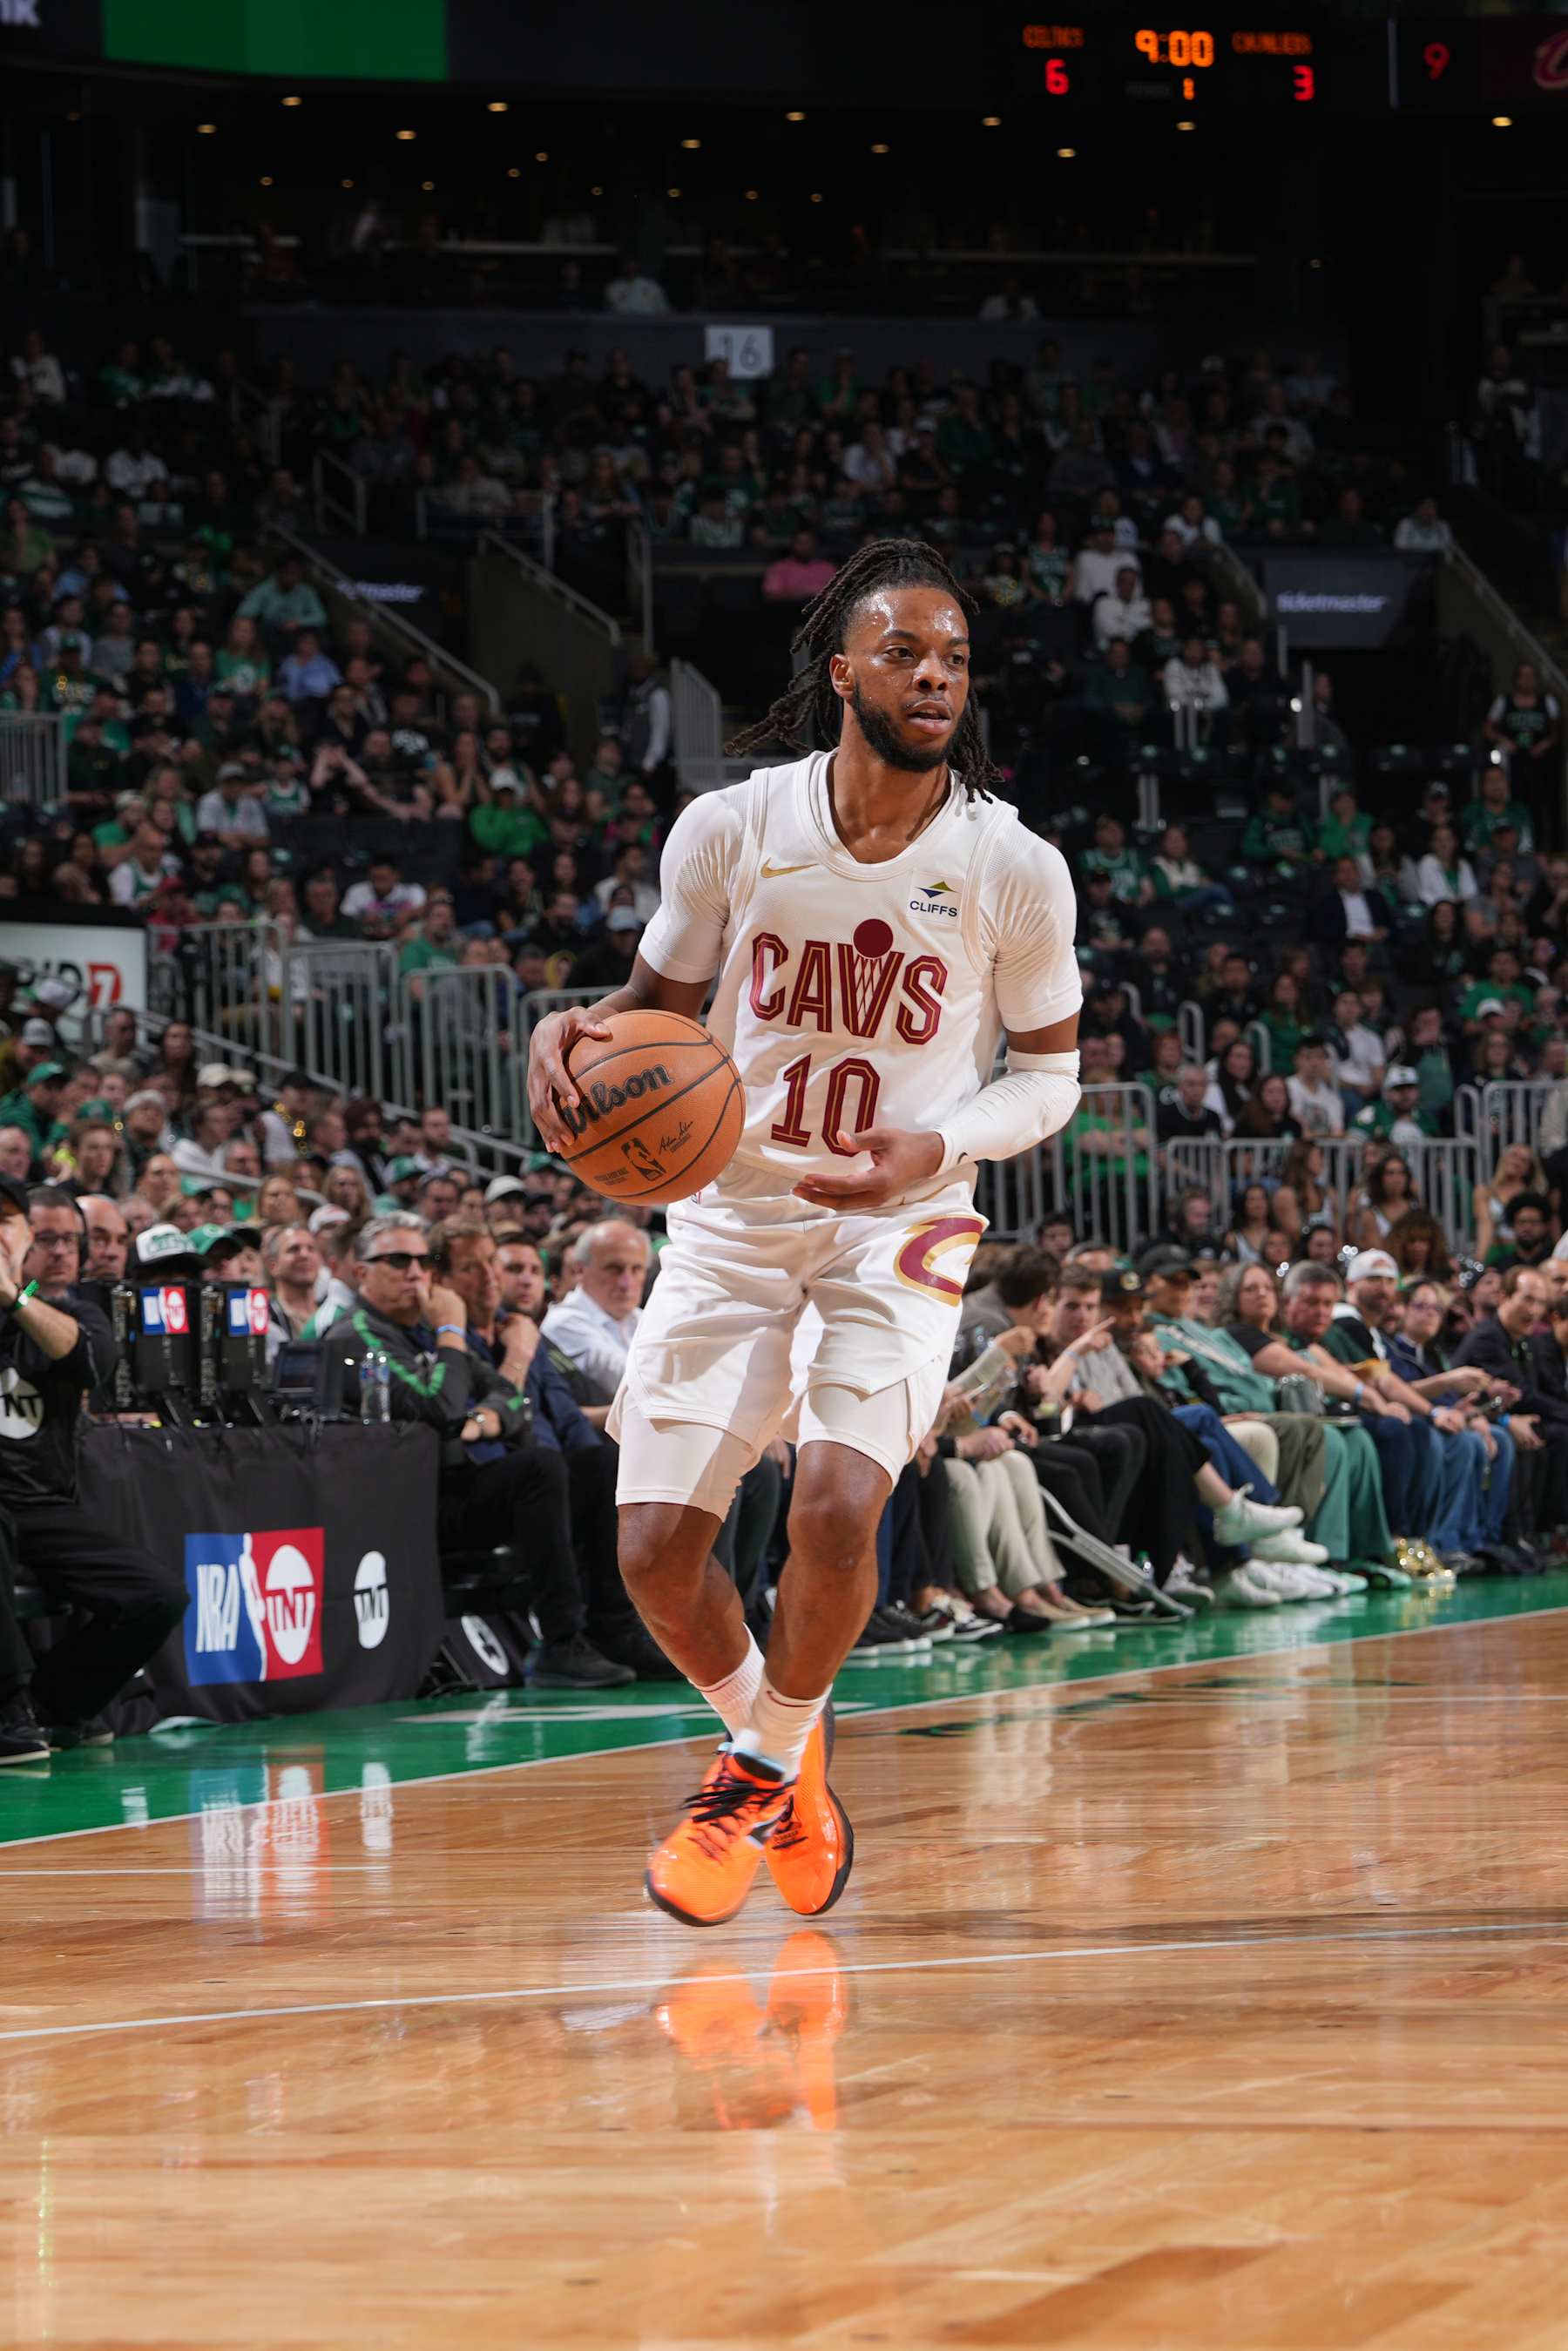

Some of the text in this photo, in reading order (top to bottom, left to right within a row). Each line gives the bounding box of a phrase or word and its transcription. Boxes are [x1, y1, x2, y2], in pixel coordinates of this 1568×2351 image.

[1134, 29, 1214, 67] 9:00
[1423, 41, 1450, 80] 9
[1045, 57, 1070, 94] 6
[1183, 78, 1195, 100] 1
[1293, 64, 1315, 101] 3
[716, 332, 764, 370] 16
[909, 900, 957, 917] CLIFFS
[749, 931, 949, 1045] CAVS
[771, 1053, 881, 1157] 10
[195, 1564, 240, 1653] NBA
